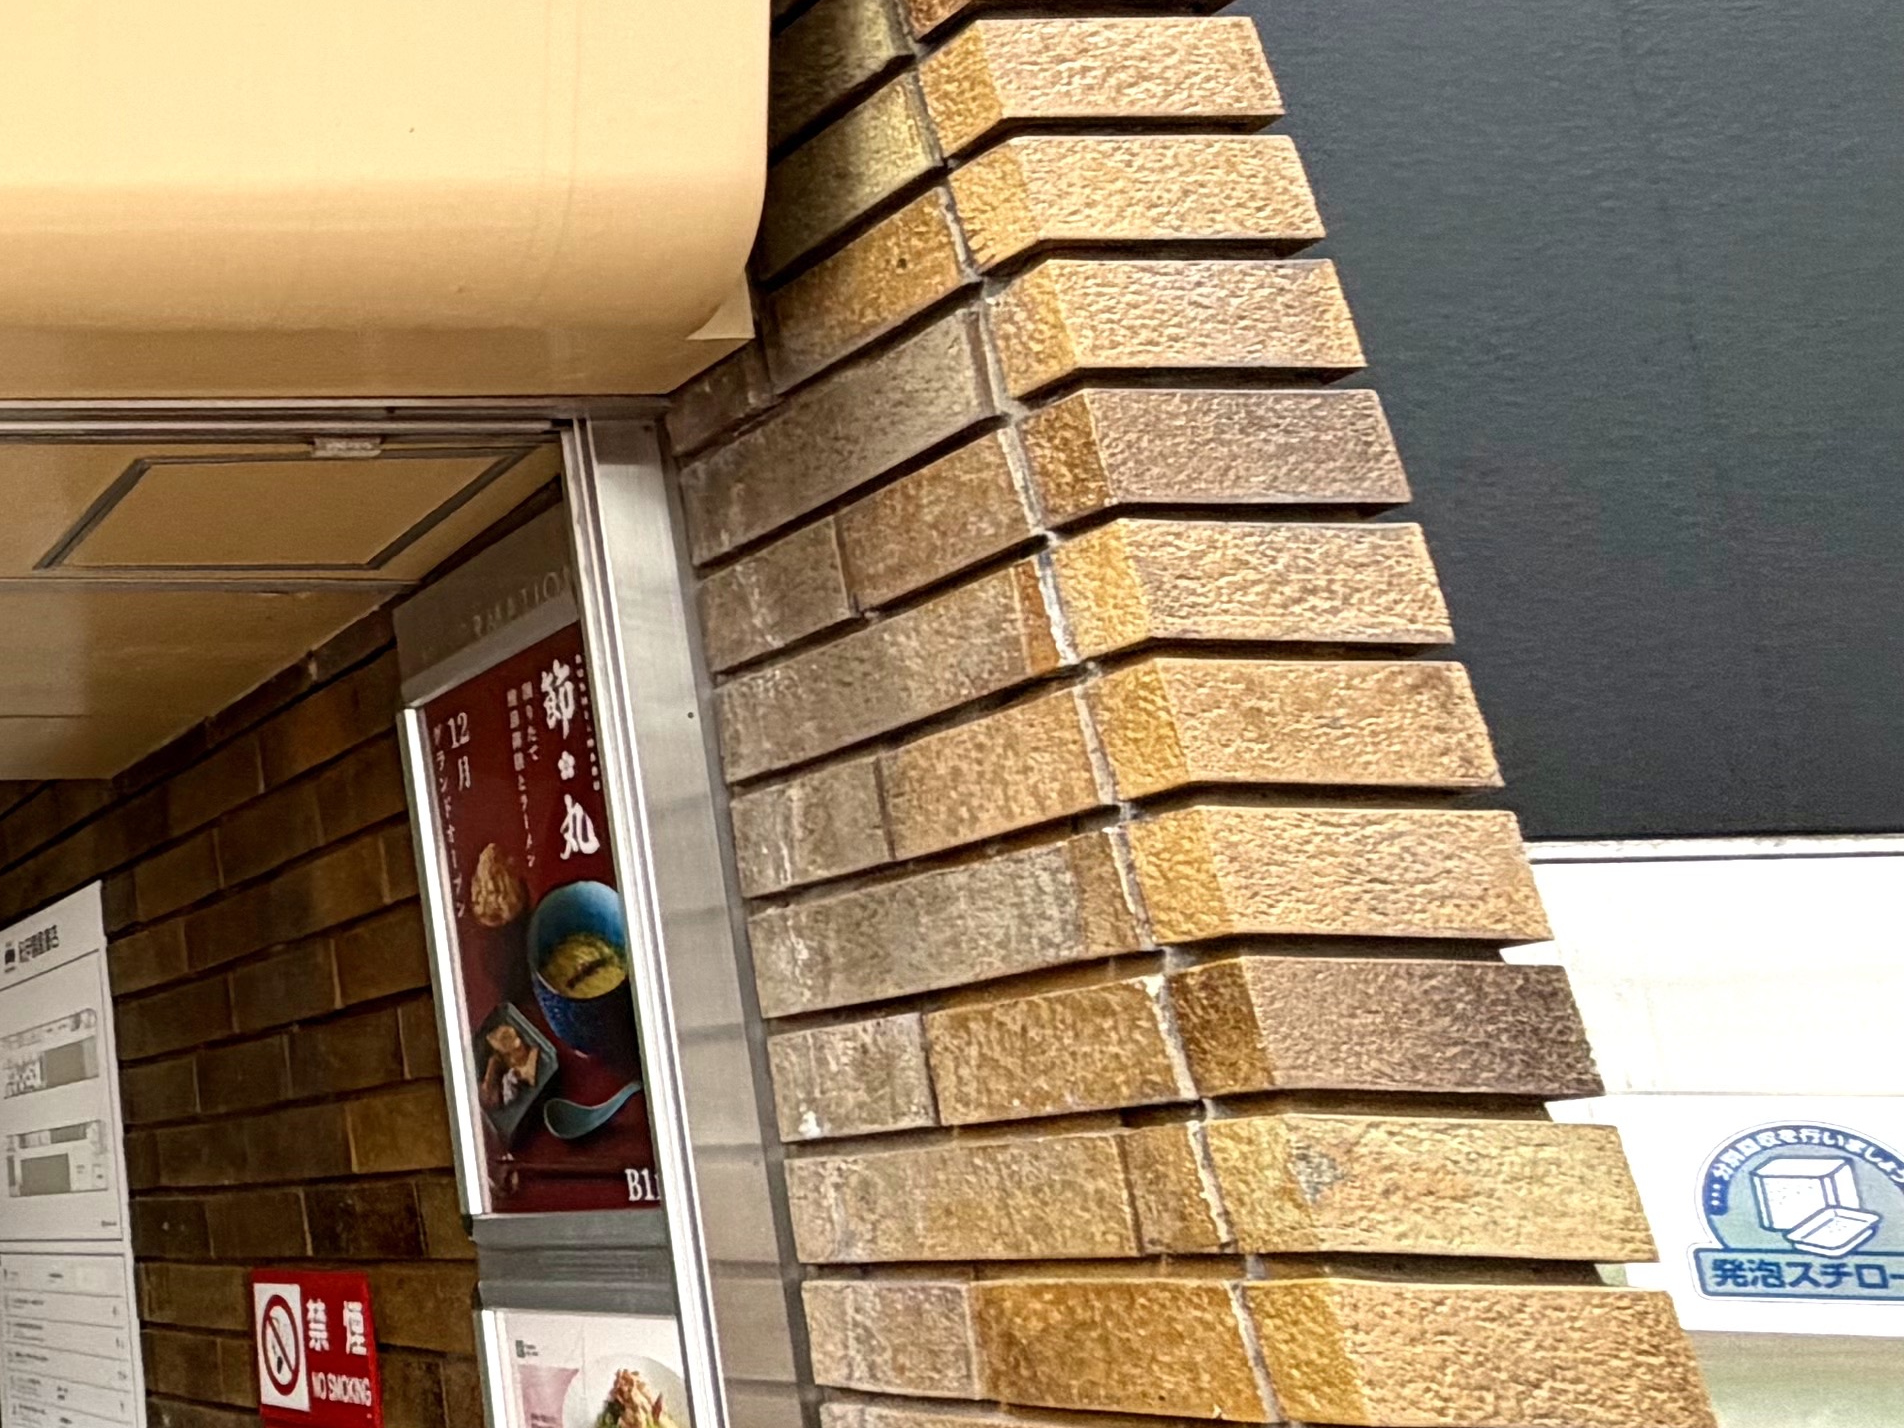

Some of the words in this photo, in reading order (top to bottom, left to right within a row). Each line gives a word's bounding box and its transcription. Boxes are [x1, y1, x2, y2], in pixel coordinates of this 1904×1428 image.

[305, 1298, 368, 1356] 禁煙
[311, 1371, 327, 1402] NO
[327, 1373, 372, 1406] SMOKING
